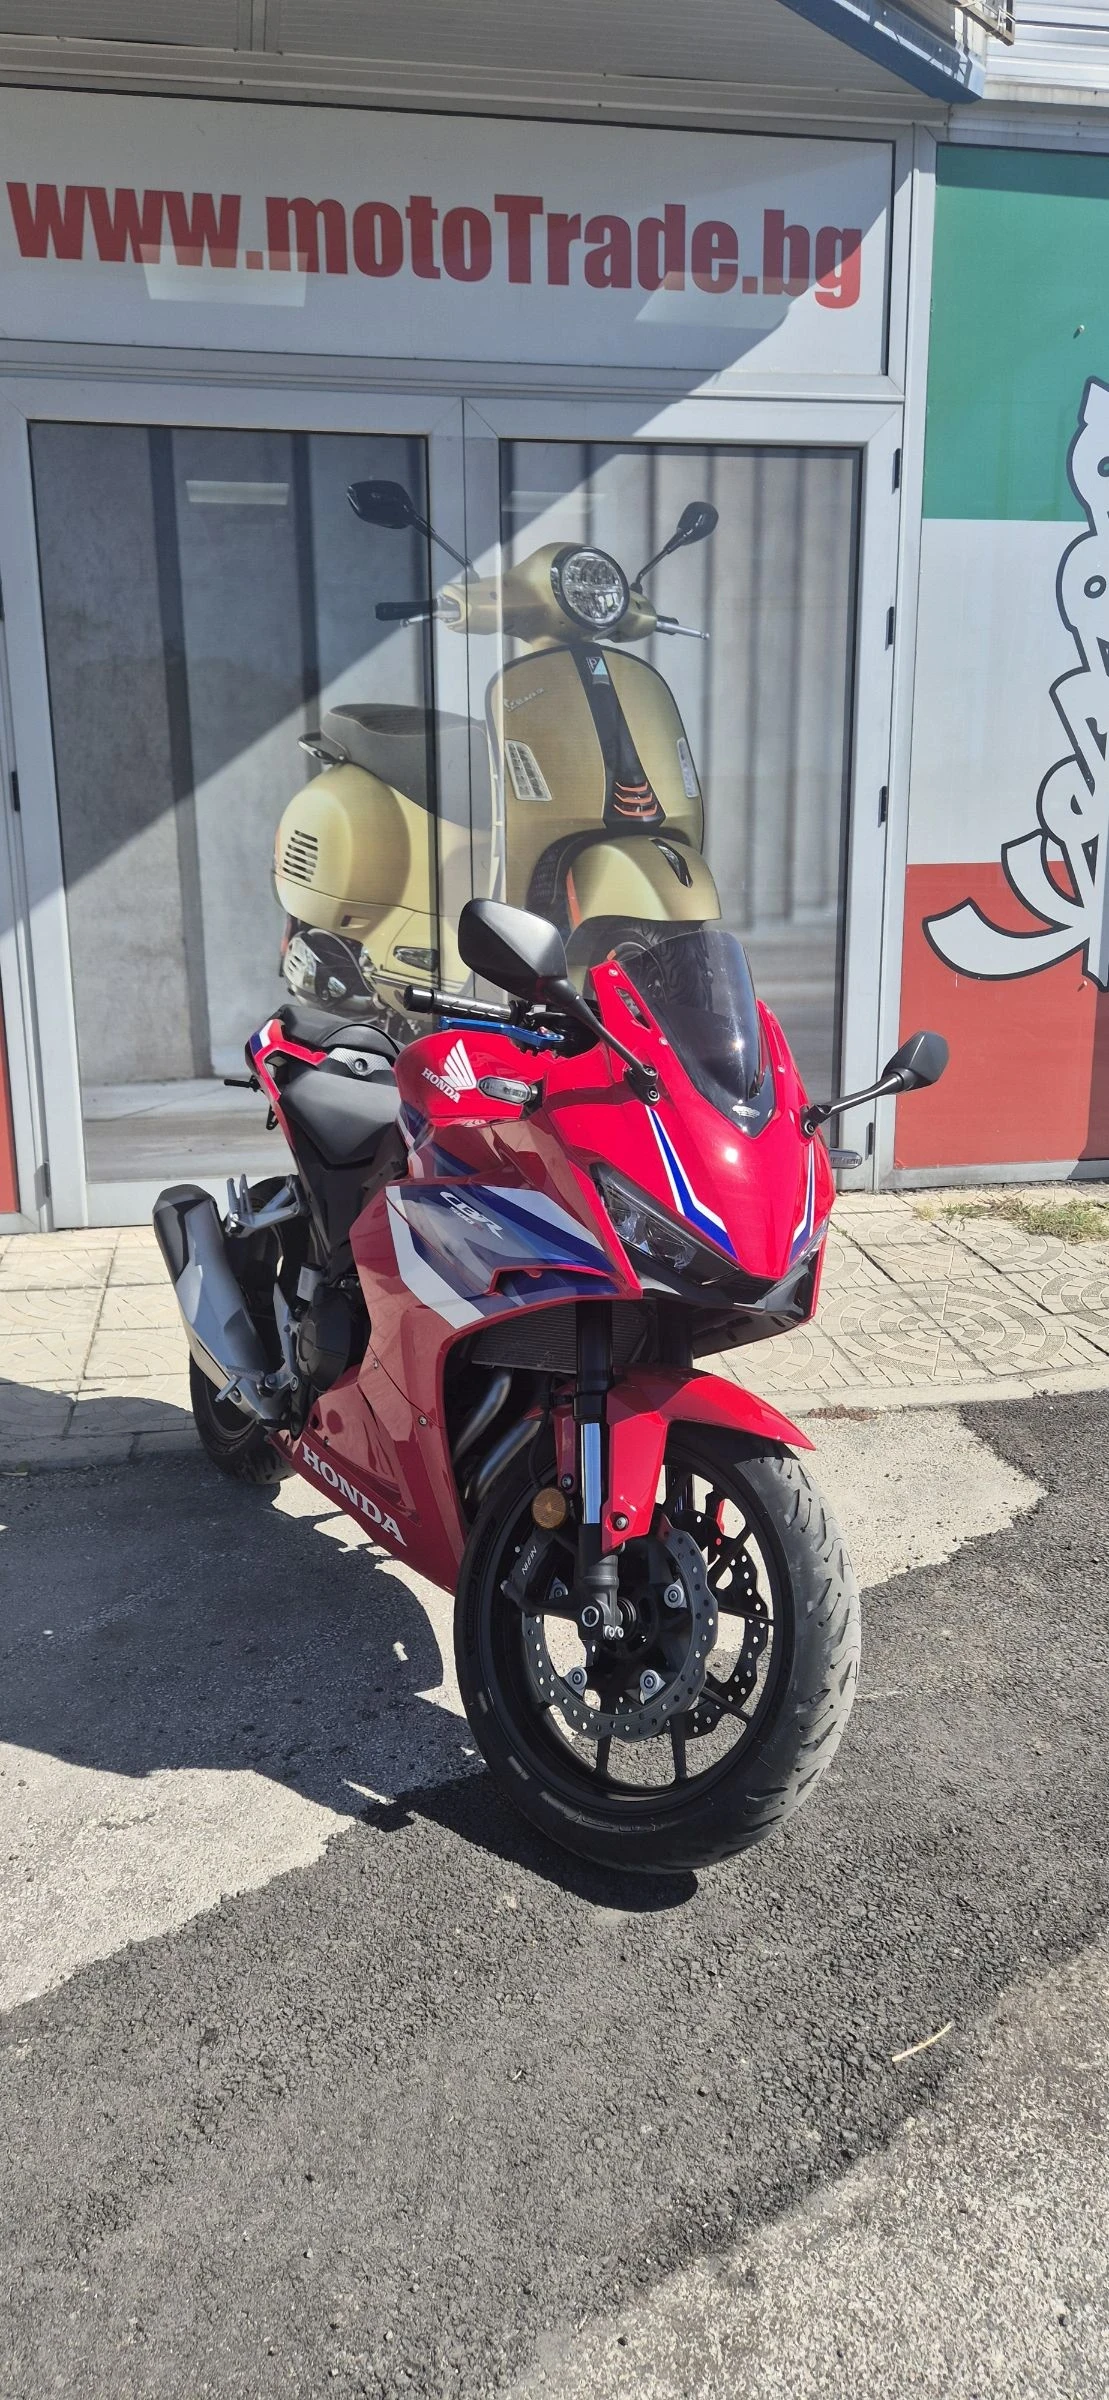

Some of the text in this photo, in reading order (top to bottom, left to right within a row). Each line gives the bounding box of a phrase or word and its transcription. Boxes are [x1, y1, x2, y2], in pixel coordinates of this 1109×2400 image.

[6, 181, 862, 309] www.motoTrade.bg
[421, 1067, 461, 1103] HONDA
[440, 1191, 503, 1240] CBR
[302, 1441, 407, 1547] HONDA
